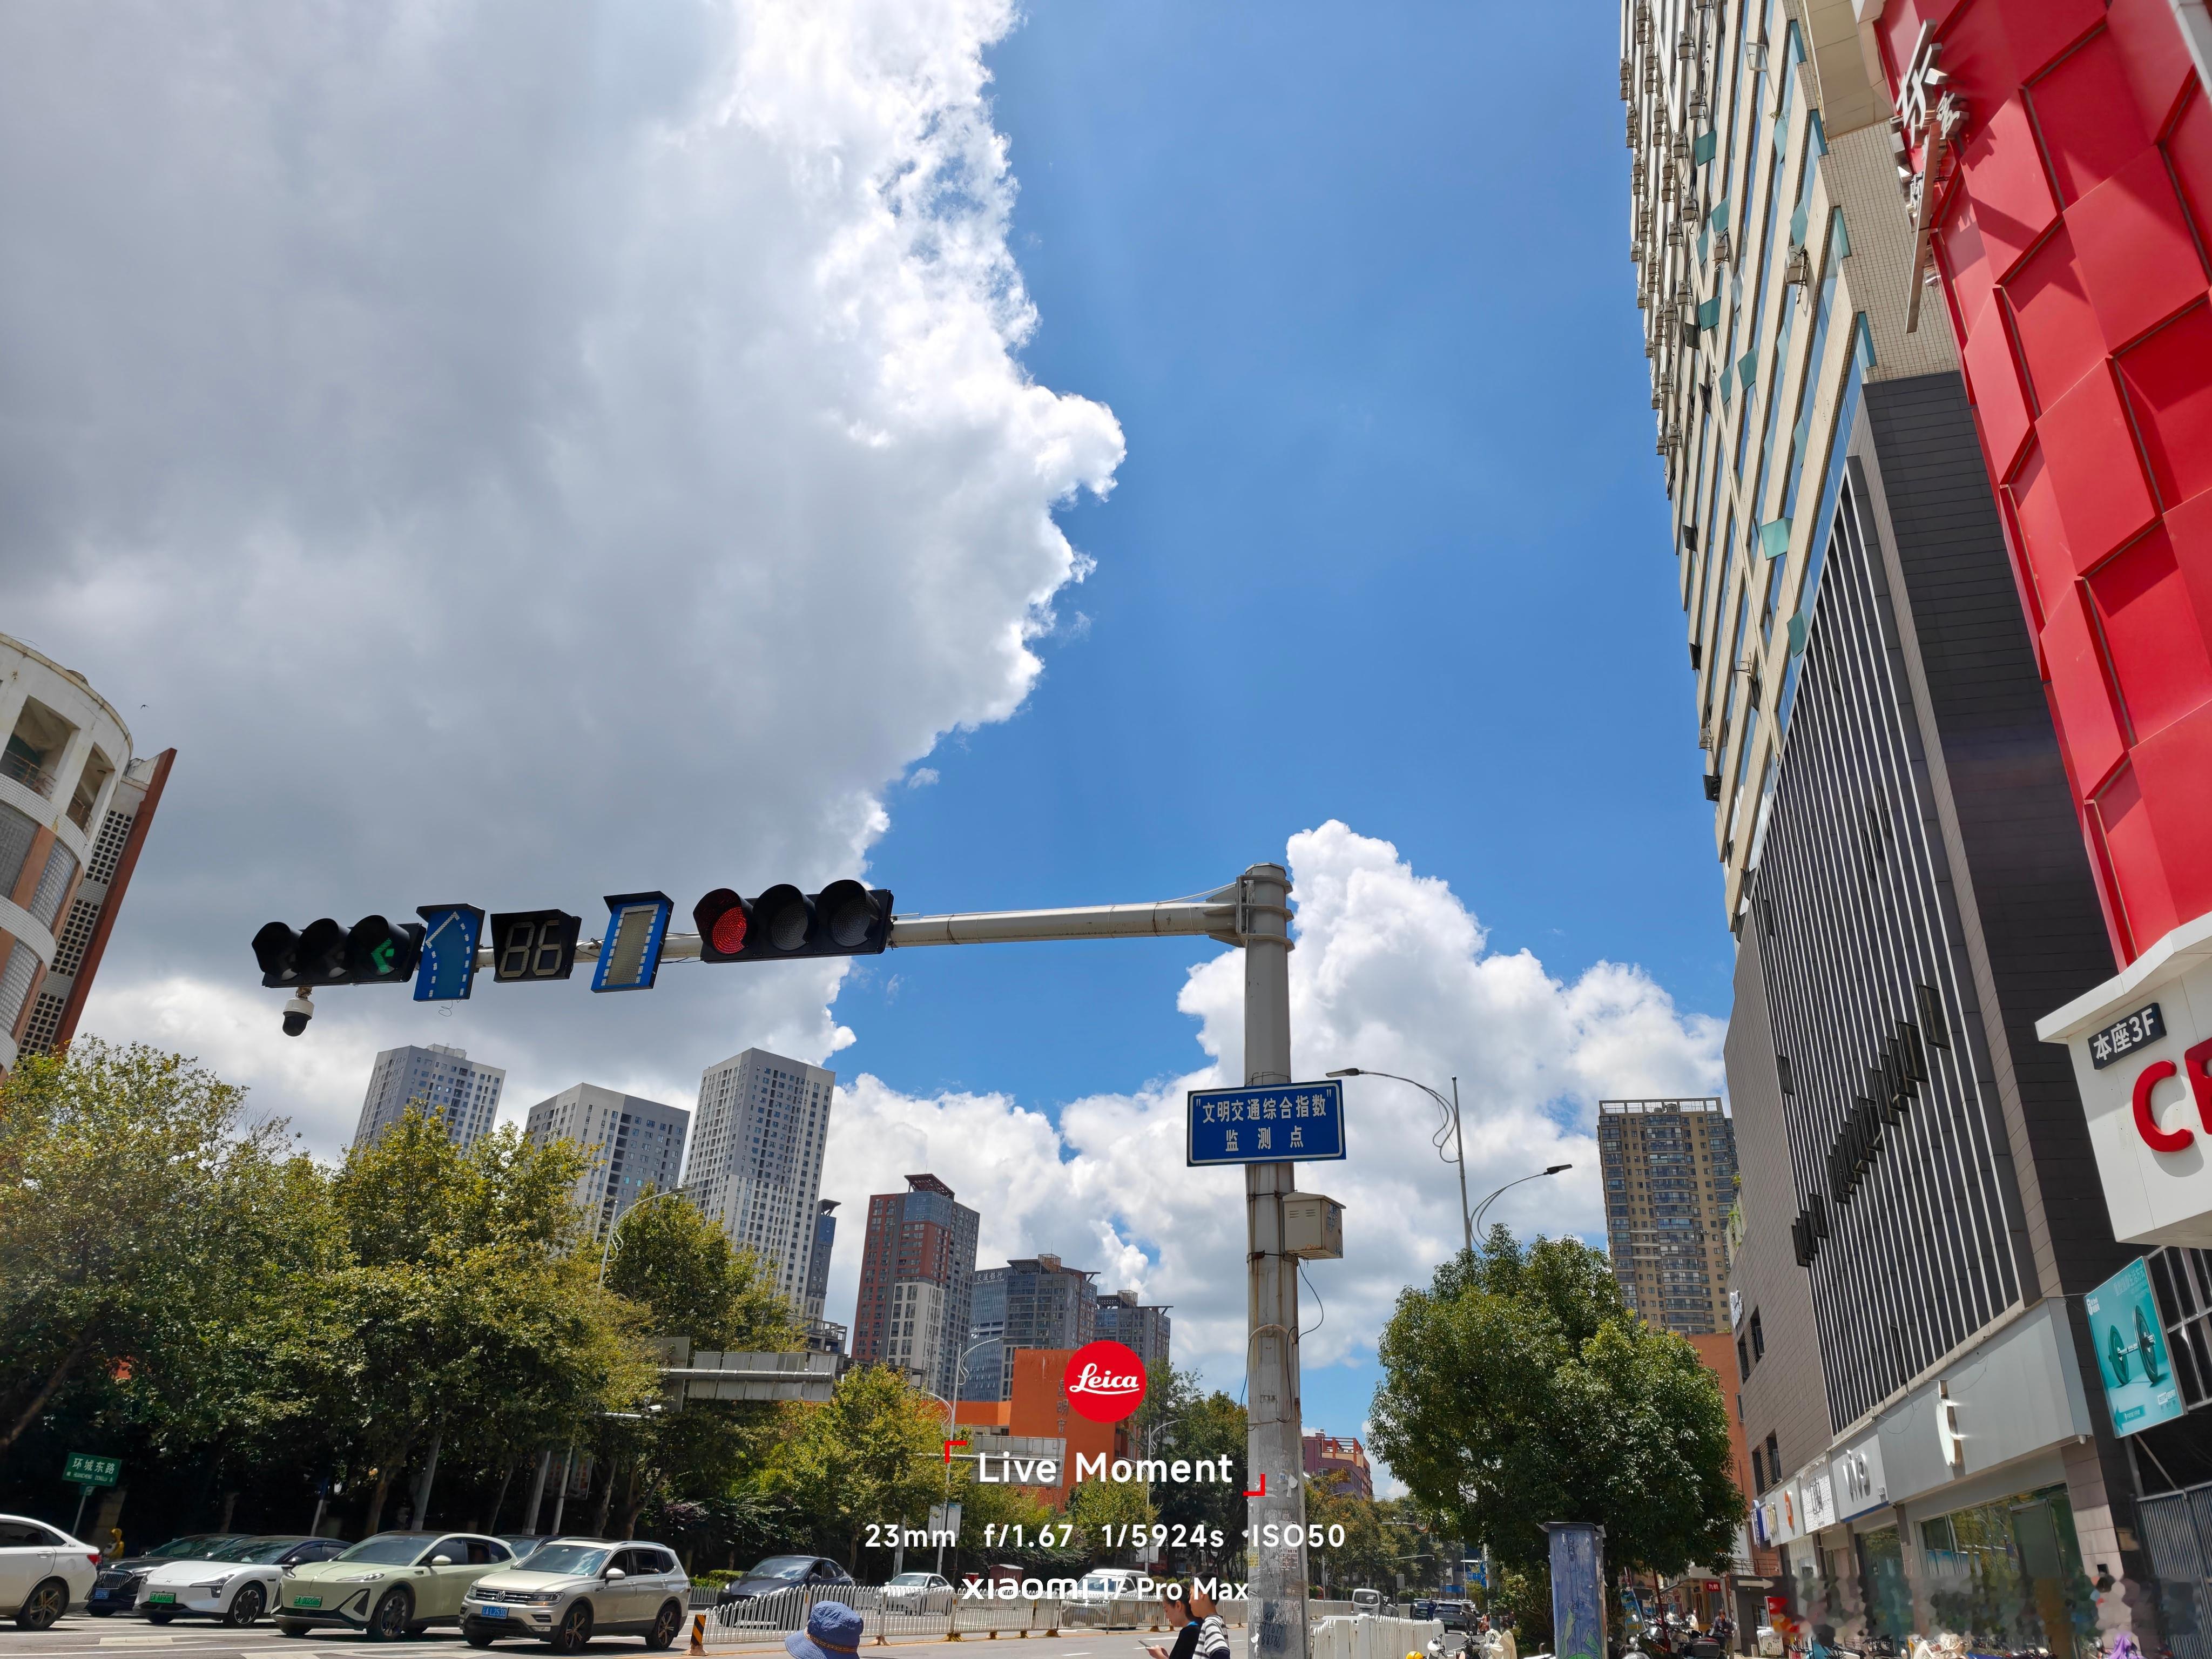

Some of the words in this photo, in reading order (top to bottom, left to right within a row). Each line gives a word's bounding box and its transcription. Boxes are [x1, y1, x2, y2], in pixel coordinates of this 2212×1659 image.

[2093, 1008, 2154, 1061] 本座3F
[1225, 1125, 1304, 1152] 监测点
[72, 1458, 115, 1474] 环城东路
